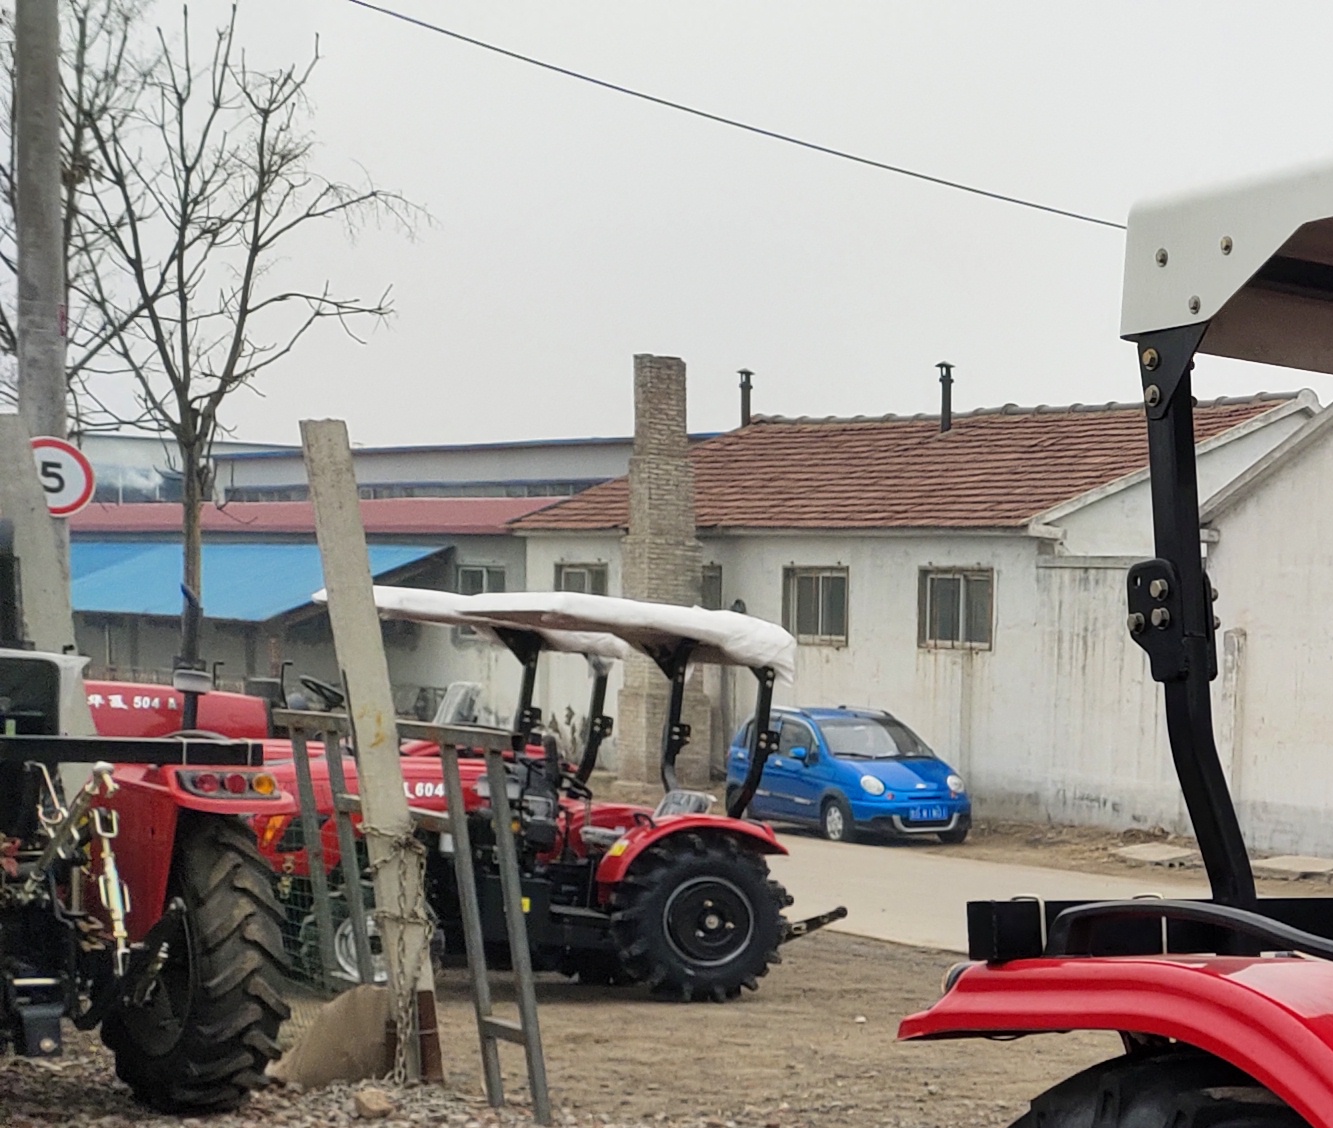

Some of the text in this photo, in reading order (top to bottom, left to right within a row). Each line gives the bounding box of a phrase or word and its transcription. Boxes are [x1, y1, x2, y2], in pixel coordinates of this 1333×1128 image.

[41, 461, 65, 494] 5
[133, 695, 160, 709] 504
[415, 782, 445, 797] 604
